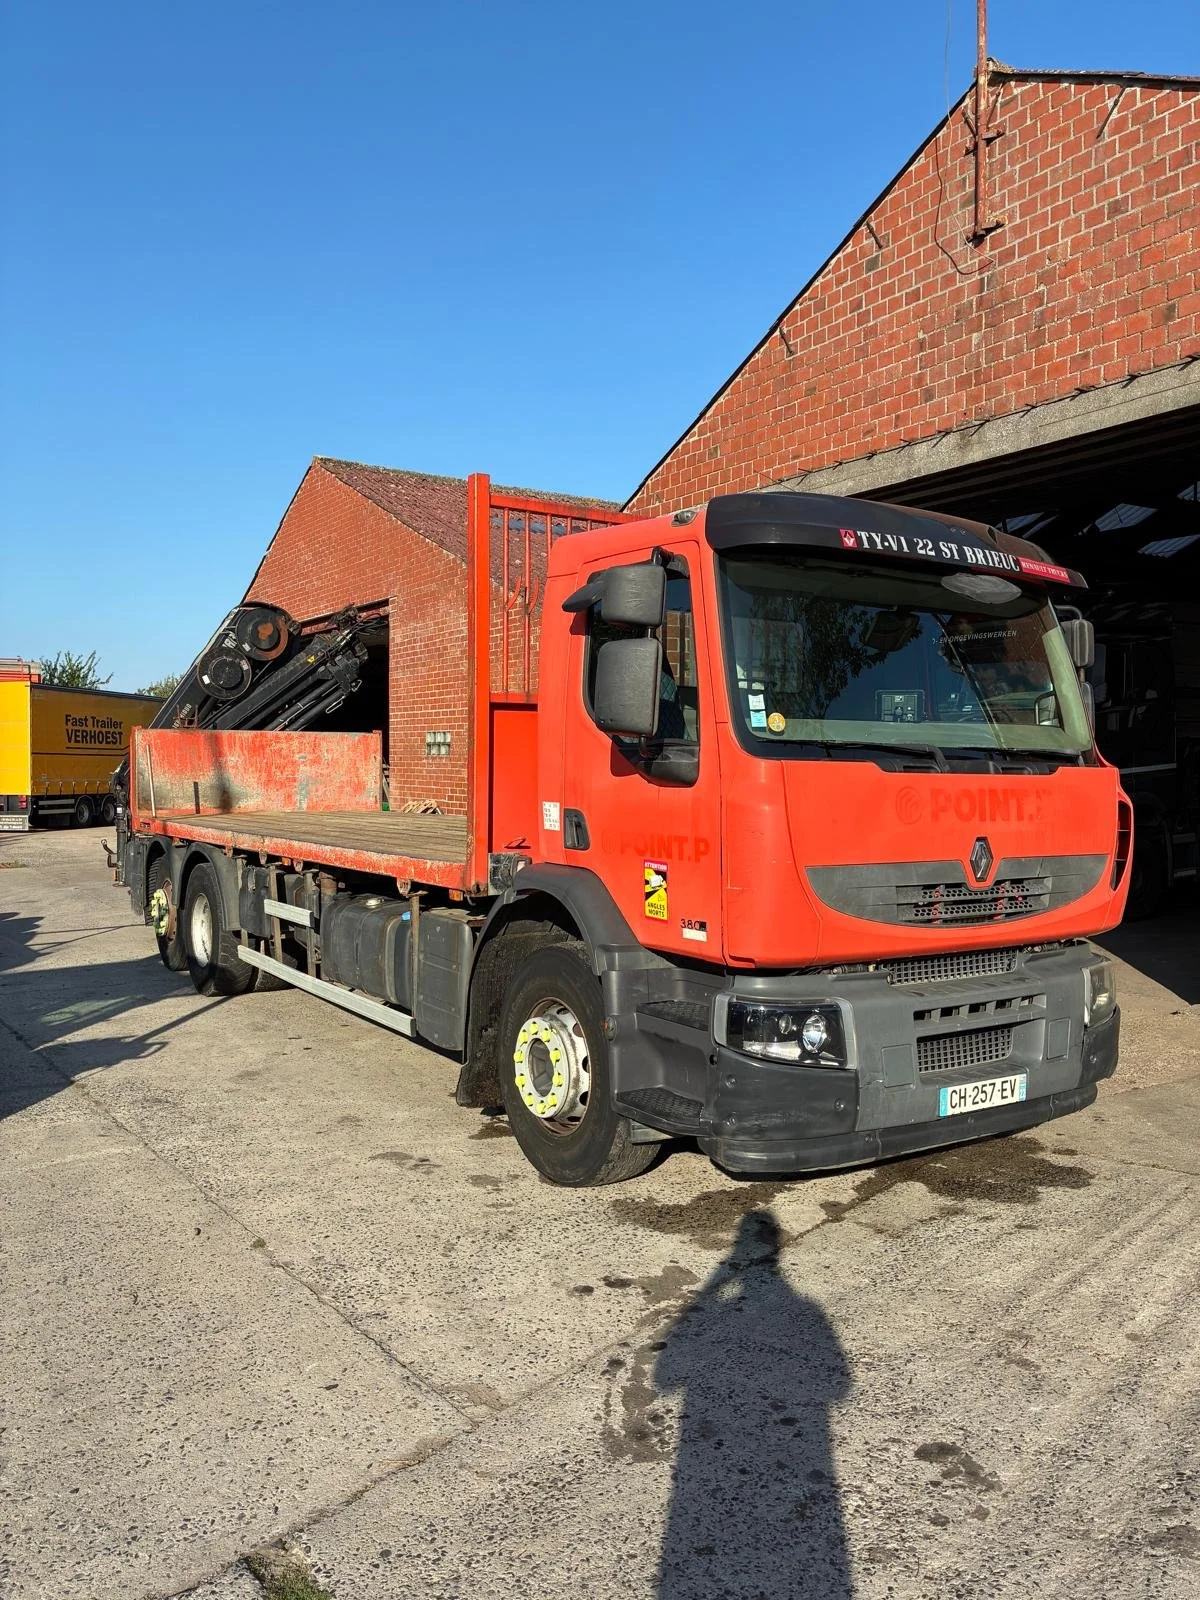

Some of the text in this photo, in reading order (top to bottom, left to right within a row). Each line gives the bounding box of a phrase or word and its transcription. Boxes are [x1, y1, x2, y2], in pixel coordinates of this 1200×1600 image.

[913, 538, 936, 556] 22
[939, 541, 960, 560] ST
[962, 545, 1020, 572] BRIEUC
[64, 713, 124, 729] Fast Trailer
[65, 728, 124, 745] VERHOEST
[647, 901, 665, 911] ANGLES
[648, 908, 665, 918] MORTS
